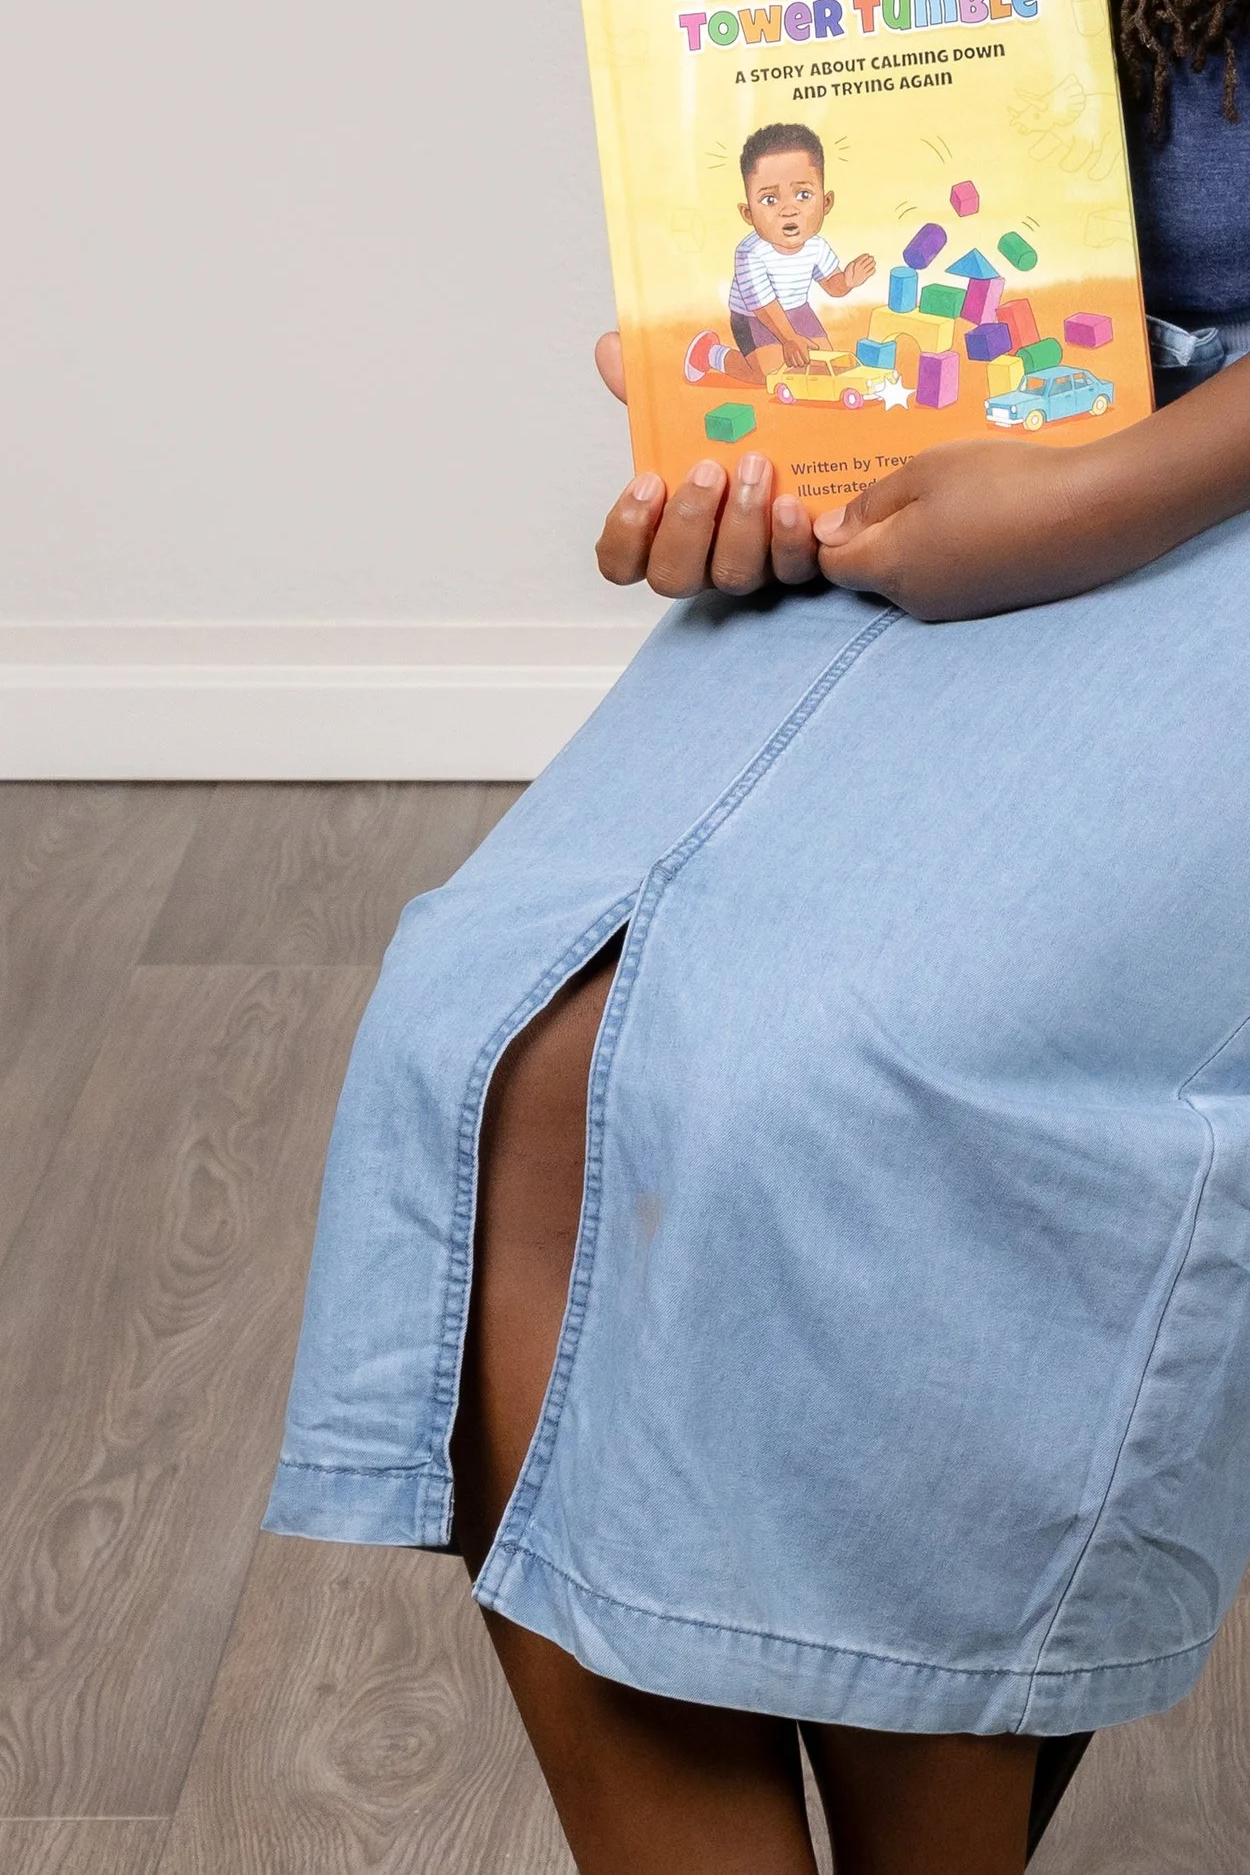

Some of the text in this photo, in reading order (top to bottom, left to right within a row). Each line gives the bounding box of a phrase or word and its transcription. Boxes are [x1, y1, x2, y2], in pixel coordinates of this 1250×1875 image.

[735, 43, 1005, 84] A STORY ABOUT CALMING DOWN
[792, 71, 953, 101] AND TRYING AGAIN
[791, 461, 848, 476] Written
[853, 458, 871, 472] by
